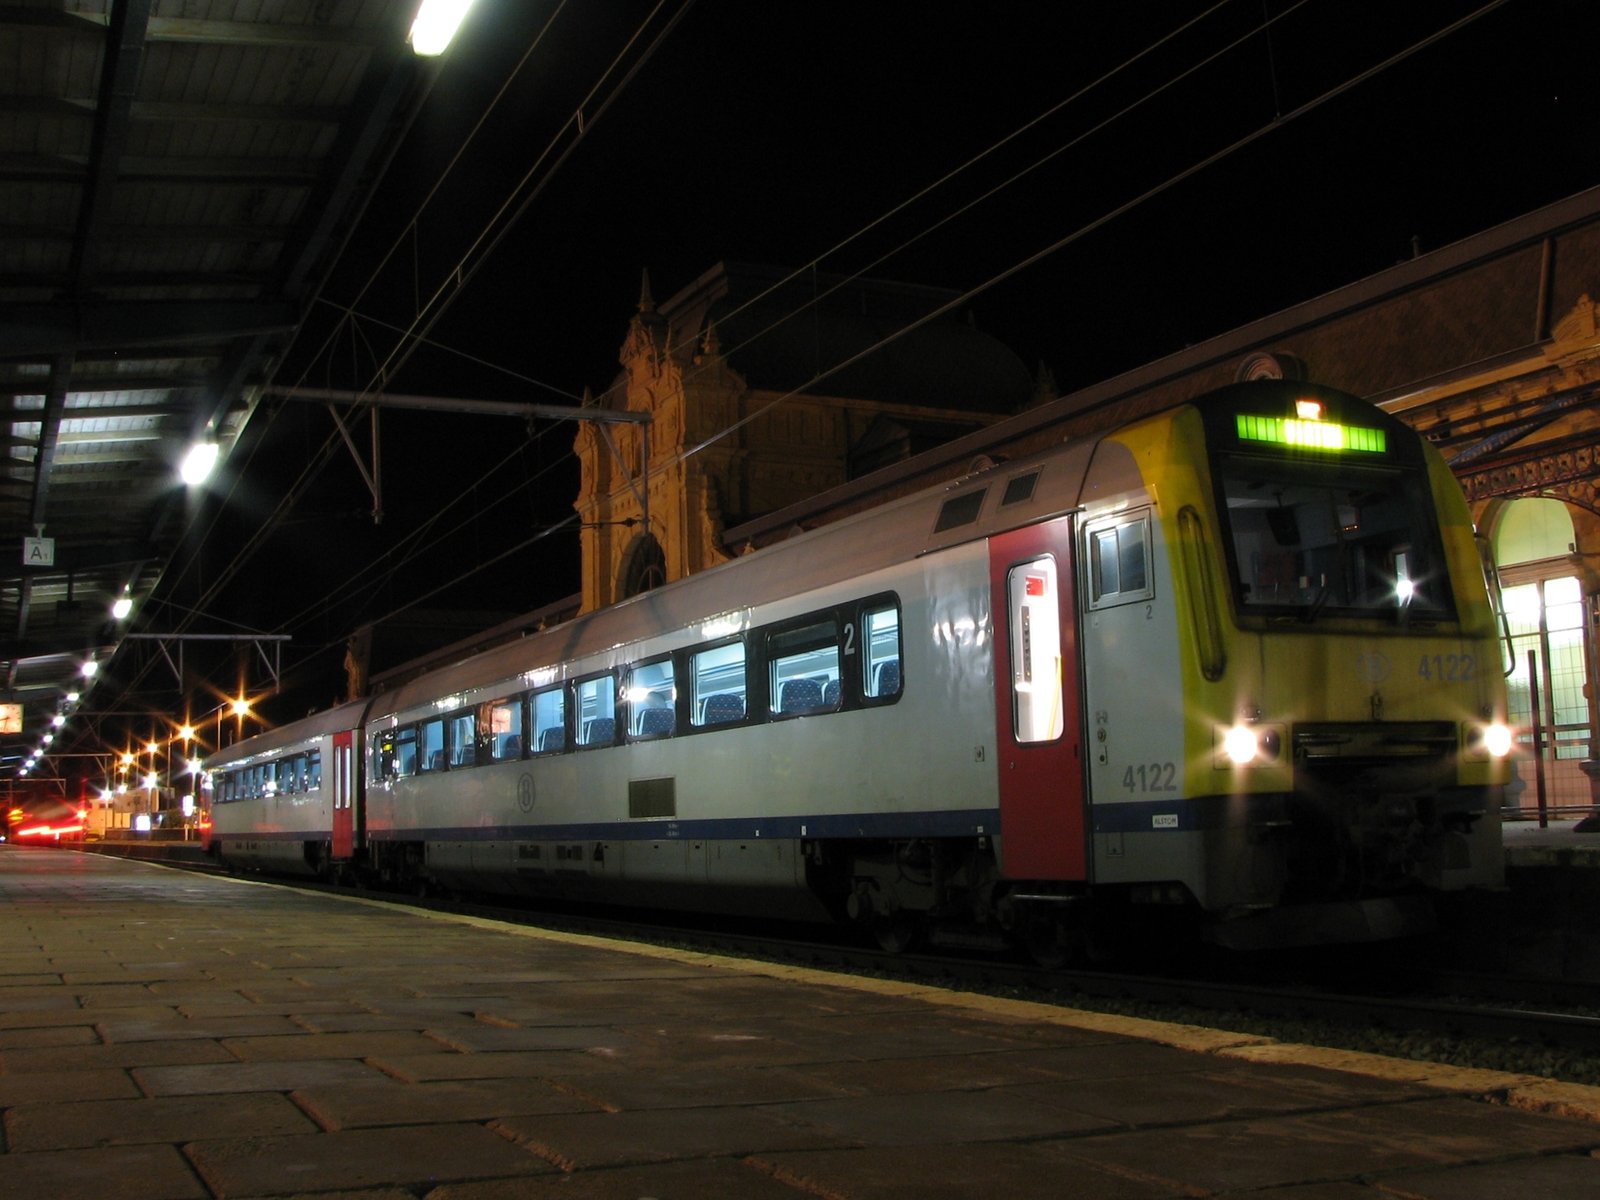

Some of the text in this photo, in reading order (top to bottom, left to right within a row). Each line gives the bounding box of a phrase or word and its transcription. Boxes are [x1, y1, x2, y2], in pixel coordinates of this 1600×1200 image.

[31, 546, 42, 560] A
[1146, 604, 1153, 620] 2
[843, 622, 855, 655] 2
[1418, 654, 1477, 682] 4122
[1123, 762, 1177, 793] 4122
